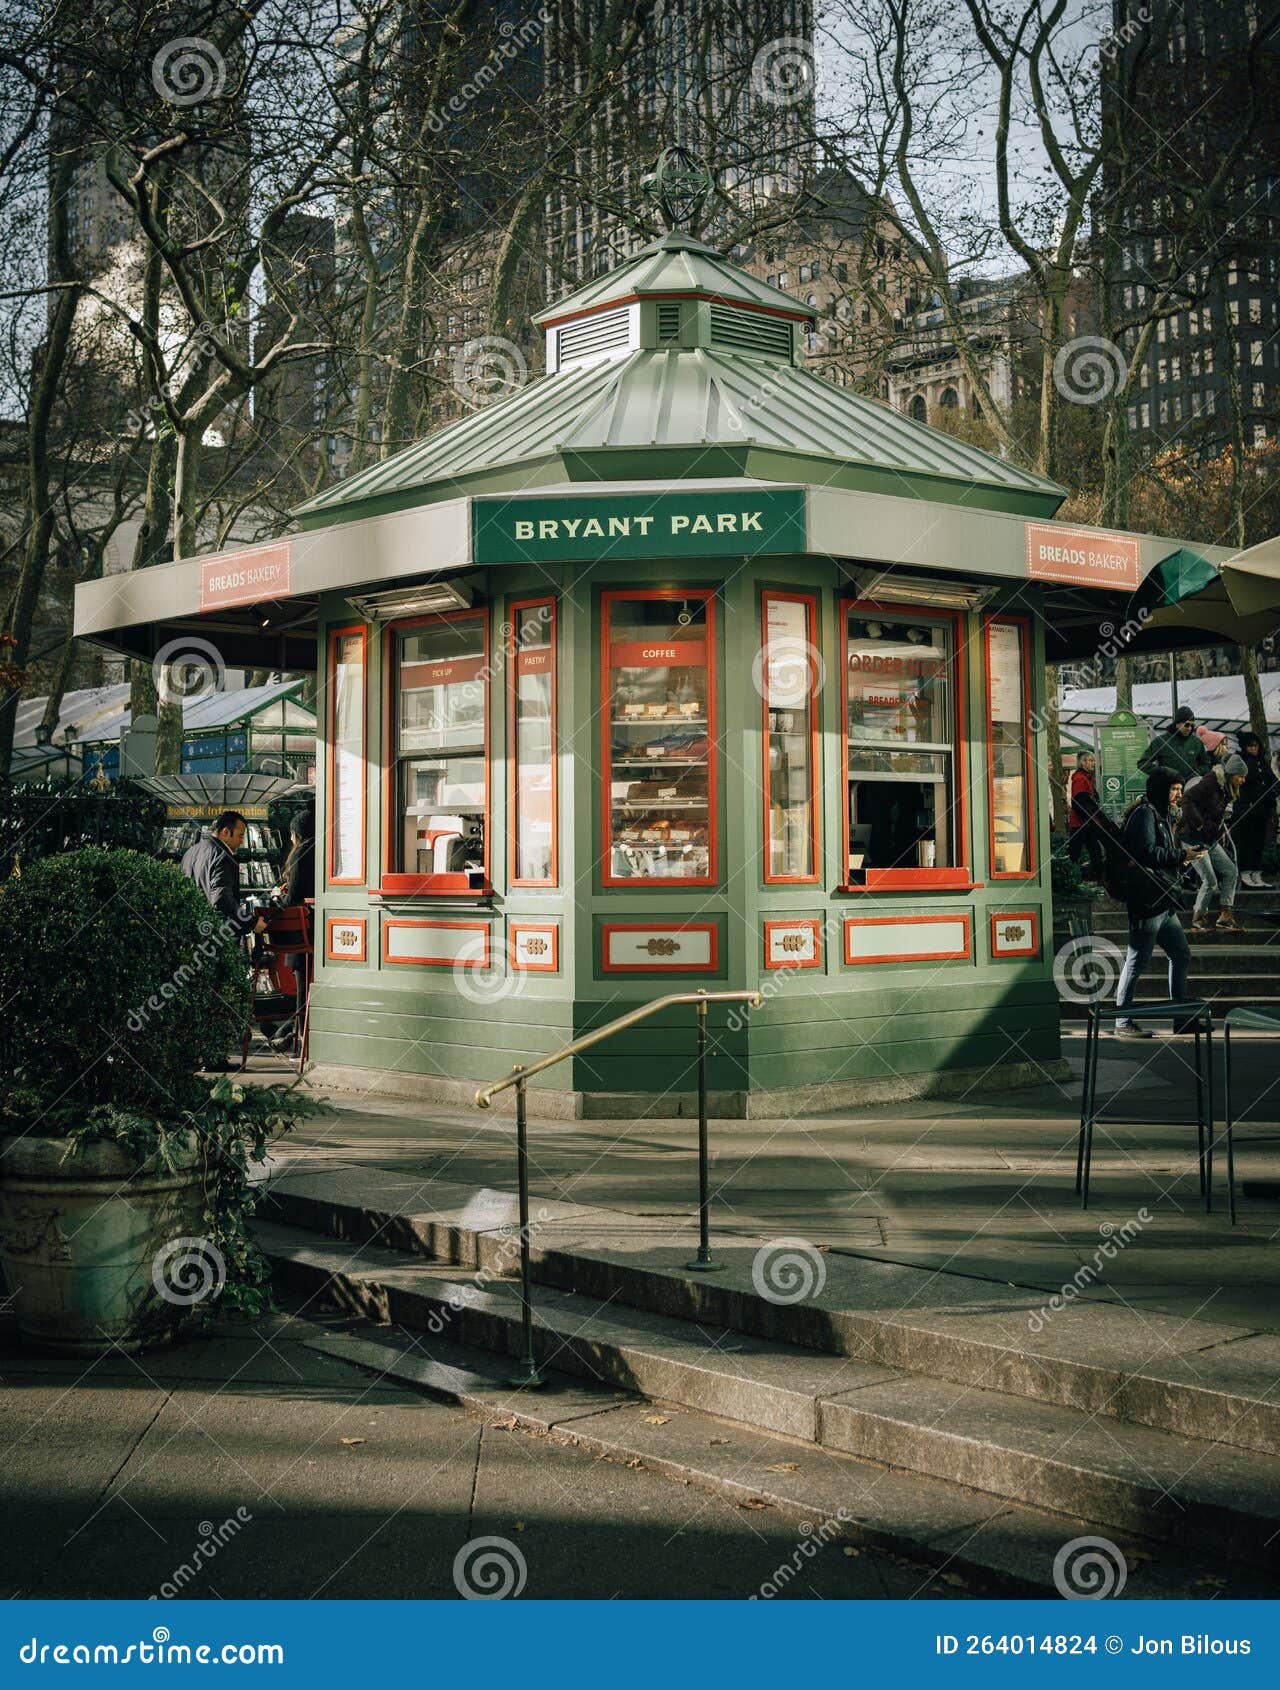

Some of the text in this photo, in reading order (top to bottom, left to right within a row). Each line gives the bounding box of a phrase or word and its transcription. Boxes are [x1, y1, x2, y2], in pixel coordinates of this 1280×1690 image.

[515, 511, 763, 540] BRYANT PARK
[1039, 545, 1128, 572] BREADS BAKERY
[209, 564, 281, 592] BREADS BAKERY
[523, 655, 546, 666] PASTRY
[642, 649, 676, 658] COFFEE
[432, 668, 453, 679] PICK UP
[849, 654, 946, 678] ORDER HERE
